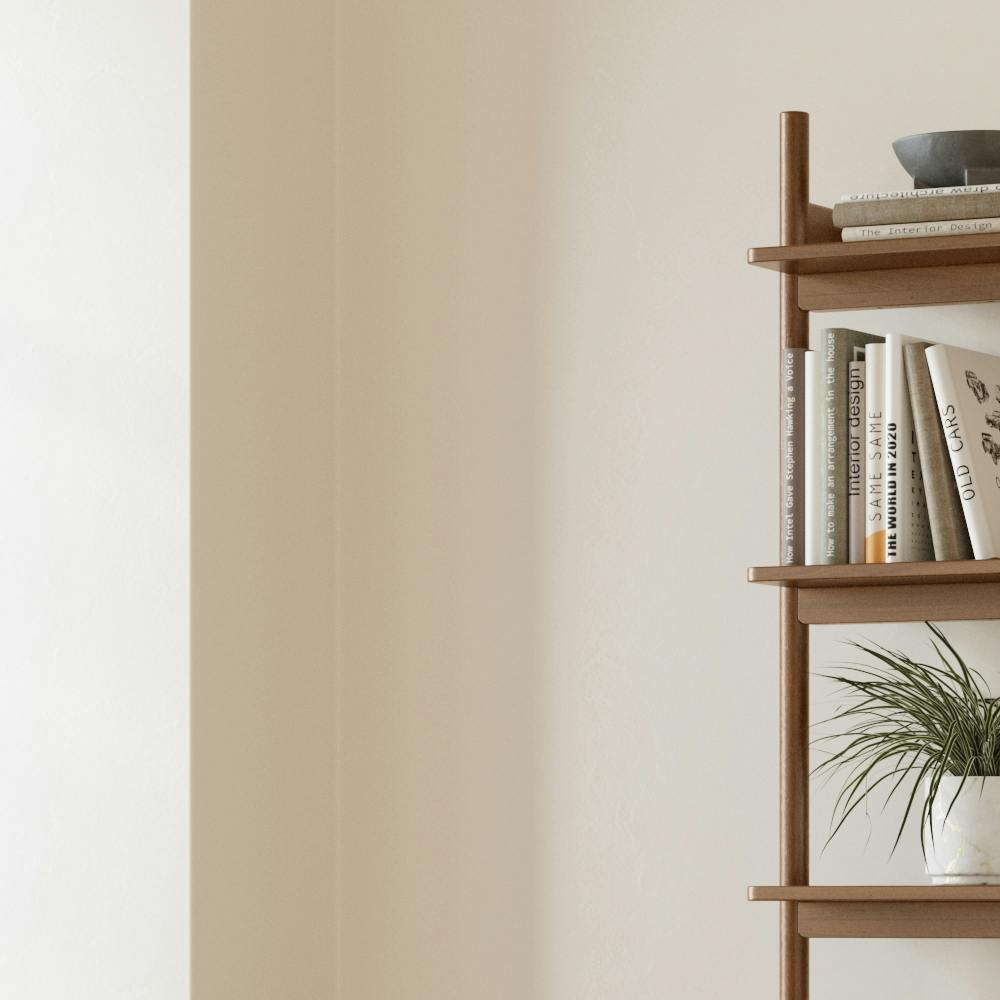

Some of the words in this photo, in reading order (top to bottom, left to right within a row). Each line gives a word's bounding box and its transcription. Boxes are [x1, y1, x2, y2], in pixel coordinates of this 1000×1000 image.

[849, 188, 945, 200] architecture
[861, 229, 881, 238] The
[888, 225, 943, 235] Interior
[950, 221, 992, 232] Design
[826, 332, 835, 362] house
[785, 352, 794, 382] Voice
[826, 367, 835, 384] the
[826, 390, 835, 401] in
[848, 368, 864, 428] design
[785, 396, 796, 437] Hawking
[942, 404, 964, 452] CARS
[826, 407, 838, 471] arrangement
[869, 411, 882, 460] SAME
[887, 422, 897, 459] 2020
[785, 441, 796, 480] Stephen
[848, 433, 861, 496] Interior
[887, 462, 897, 476] IN
[827, 475, 835, 488] an
[956, 464, 976, 501] OLD
[785, 485, 794, 508] Gave
[826, 493, 835, 517] make
[869, 472, 882, 521] SAME
[887, 480, 897, 530] WORLD
[785, 513, 794, 540] Intel
[826, 521, 835, 533] to
[785, 546, 794, 563] How
[826, 538, 835, 557] How
[887, 532, 897, 557] THE
